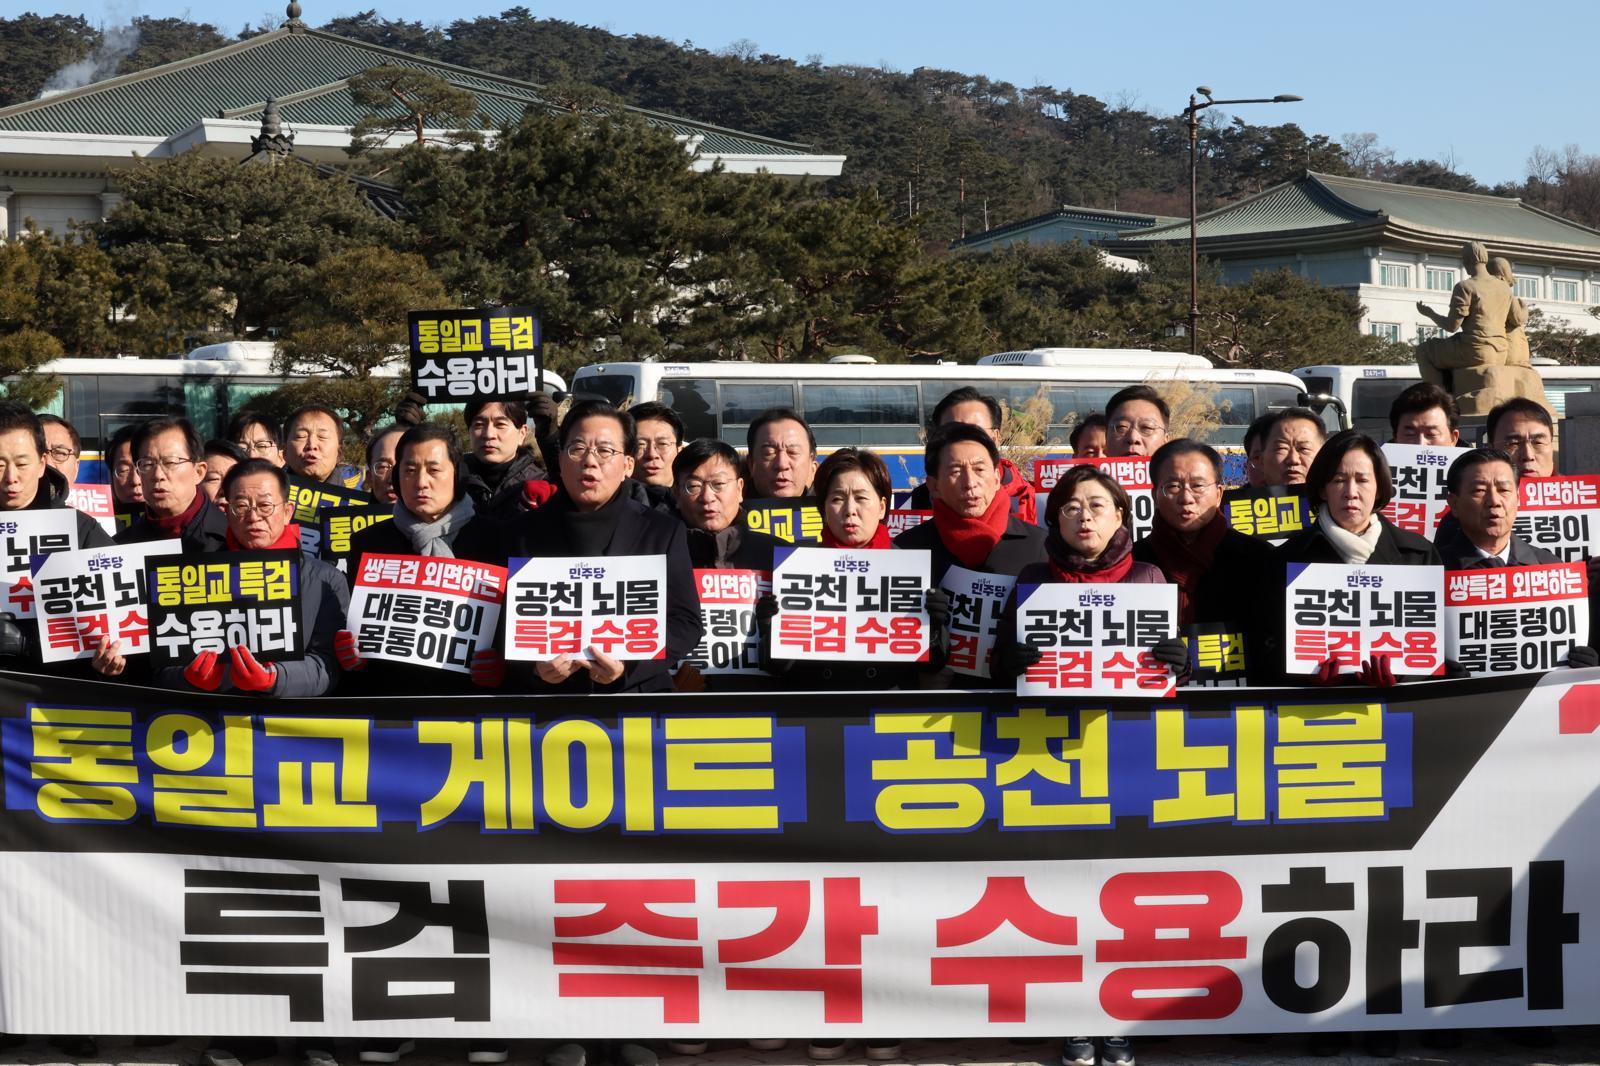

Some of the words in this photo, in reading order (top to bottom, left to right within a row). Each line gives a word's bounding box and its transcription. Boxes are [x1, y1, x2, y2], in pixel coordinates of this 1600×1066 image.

[418, 319, 484, 353] 통일교
[489, 316, 534, 351] 특검
[417, 355, 539, 397] 수용하라
[1416, 454, 1448, 467] 민주당
[65, 488, 109, 513] 하는
[1525, 480, 1597, 506] 외면하는
[0, 522, 18, 534] 주당
[747, 508, 795, 543] 일교
[801, 506, 824, 542] 특
[887, 515, 934, 538] 쌍특
[1229, 496, 1303, 535] 통일교
[1512, 515, 1590, 544] 통령이
[87, 556, 124, 572] 민주당
[363, 558, 421, 585] 쌍특검
[421, 562, 500, 598] 외면하는
[569, 567, 606, 579] 민주당
[834, 560, 870, 573] 민주당
[1347, 575, 1384, 588] 민주당
[8, 576, 35, 612] 수
[40, 574, 107, 615] 공천
[112, 569, 148, 607] 뇌
[156, 564, 232, 606] 통일교
[239, 560, 292, 601] 특검
[515, 581, 582, 617] 공천
[591, 579, 659, 616] 뇌물
[780, 573, 847, 612] 공천
[856, 576, 923, 613] 뇌물
[971, 583, 1007, 598] 민주당
[1079, 594, 1116, 607] 민주당
[1449, 574, 1506, 601] 쌍특검
[1512, 568, 1582, 598] 외면하는
[362, 593, 485, 636] 대통령이
[1294, 588, 1361, 627] 공천
[1370, 591, 1437, 627] 뇌물
[1459, 604, 1576, 640] 대통령이
[47, 613, 111, 652] 특검
[118, 610, 149, 646] 수
[156, 607, 297, 657] 수용하라
[358, 623, 477, 668] 몸통이다
[514, 620, 582, 654] 특검
[591, 618, 659, 653] 수용
[779, 614, 847, 653] 특검
[855, 617, 922, 654] 수용
[1024, 609, 1093, 647] 공천
[1101, 609, 1170, 647] 뇌물
[945, 633, 979, 670] 검
[1197, 633, 1246, 672] 특검
[1294, 629, 1361, 666] 특검
[1370, 631, 1437, 668] 수용
[1458, 638, 1576, 673] 몸통이다
[1025, 651, 1093, 688] 특검
[1101, 651, 1169, 689] 수용
[30, 706, 379, 829] 통일교
[418, 715, 779, 831] 게이트
[872, 708, 1111, 830] 공천
[1152, 703, 1387, 824] 뇌물
[180, 869, 491, 1023] 특검
[552, 876, 879, 1024] 즉각
[930, 860, 1580, 1024] 수용하라
